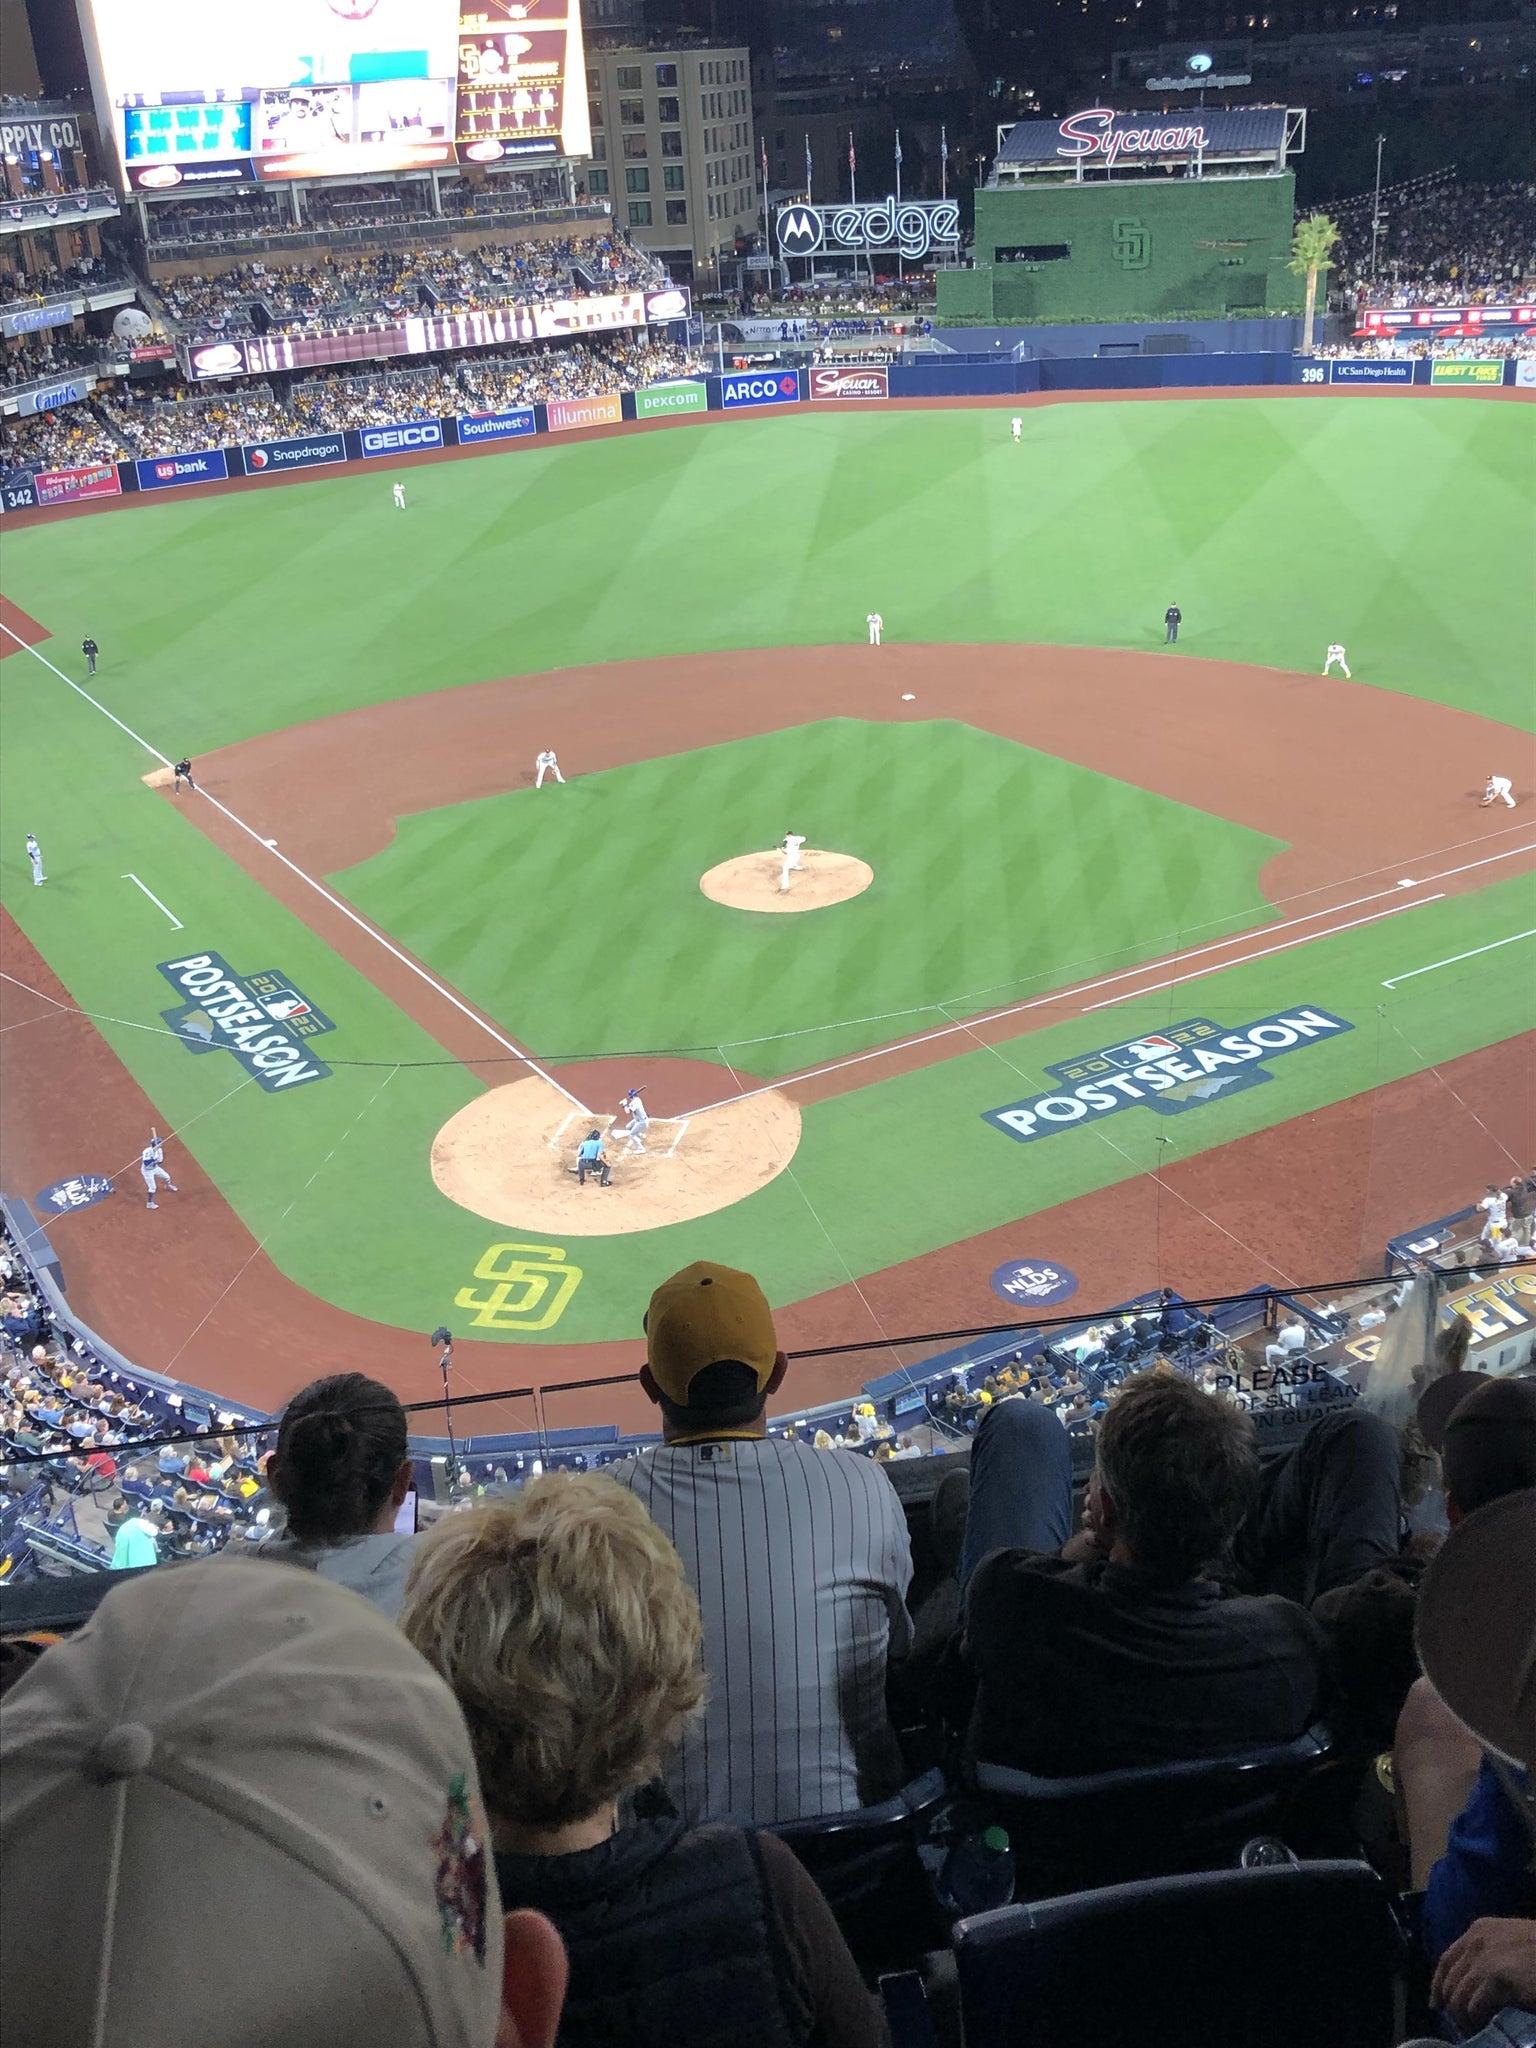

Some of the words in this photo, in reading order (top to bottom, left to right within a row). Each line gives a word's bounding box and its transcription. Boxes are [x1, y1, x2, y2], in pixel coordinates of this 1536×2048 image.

[49, 122, 79, 149] CO.
[1057, 109, 1209, 166] Sycuan
[832, 196, 960, 259] edge
[1112, 217, 1151, 269] SD
[815, 370, 880, 397] Sycuan
[1301, 368, 1324, 383] 396
[1337, 367, 1350, 376] UC
[1349, 366, 1363, 376] San
[1363, 367, 1384, 377] Diego
[1383, 367, 1406, 376] Health
[1434, 365, 1468, 376] WEST
[1468, 365, 1500, 376] LAKE
[725, 380, 778, 400] ARCO
[463, 416, 523, 436] Southwest
[552, 404, 617, 426] illumina
[364, 425, 440, 451] GEICO
[273, 443, 340, 461] Snapdragon
[174, 458, 208, 475] bank
[8, 488, 33, 508] 342
[167, 955, 320, 1088] POSTSEASON
[996, 1010, 1341, 1136] POSTSEASON
[454, 1242, 584, 1331] SD
[1002, 1268, 1059, 1294] NLDS
[1215, 1361, 1329, 1393] PLEASE
